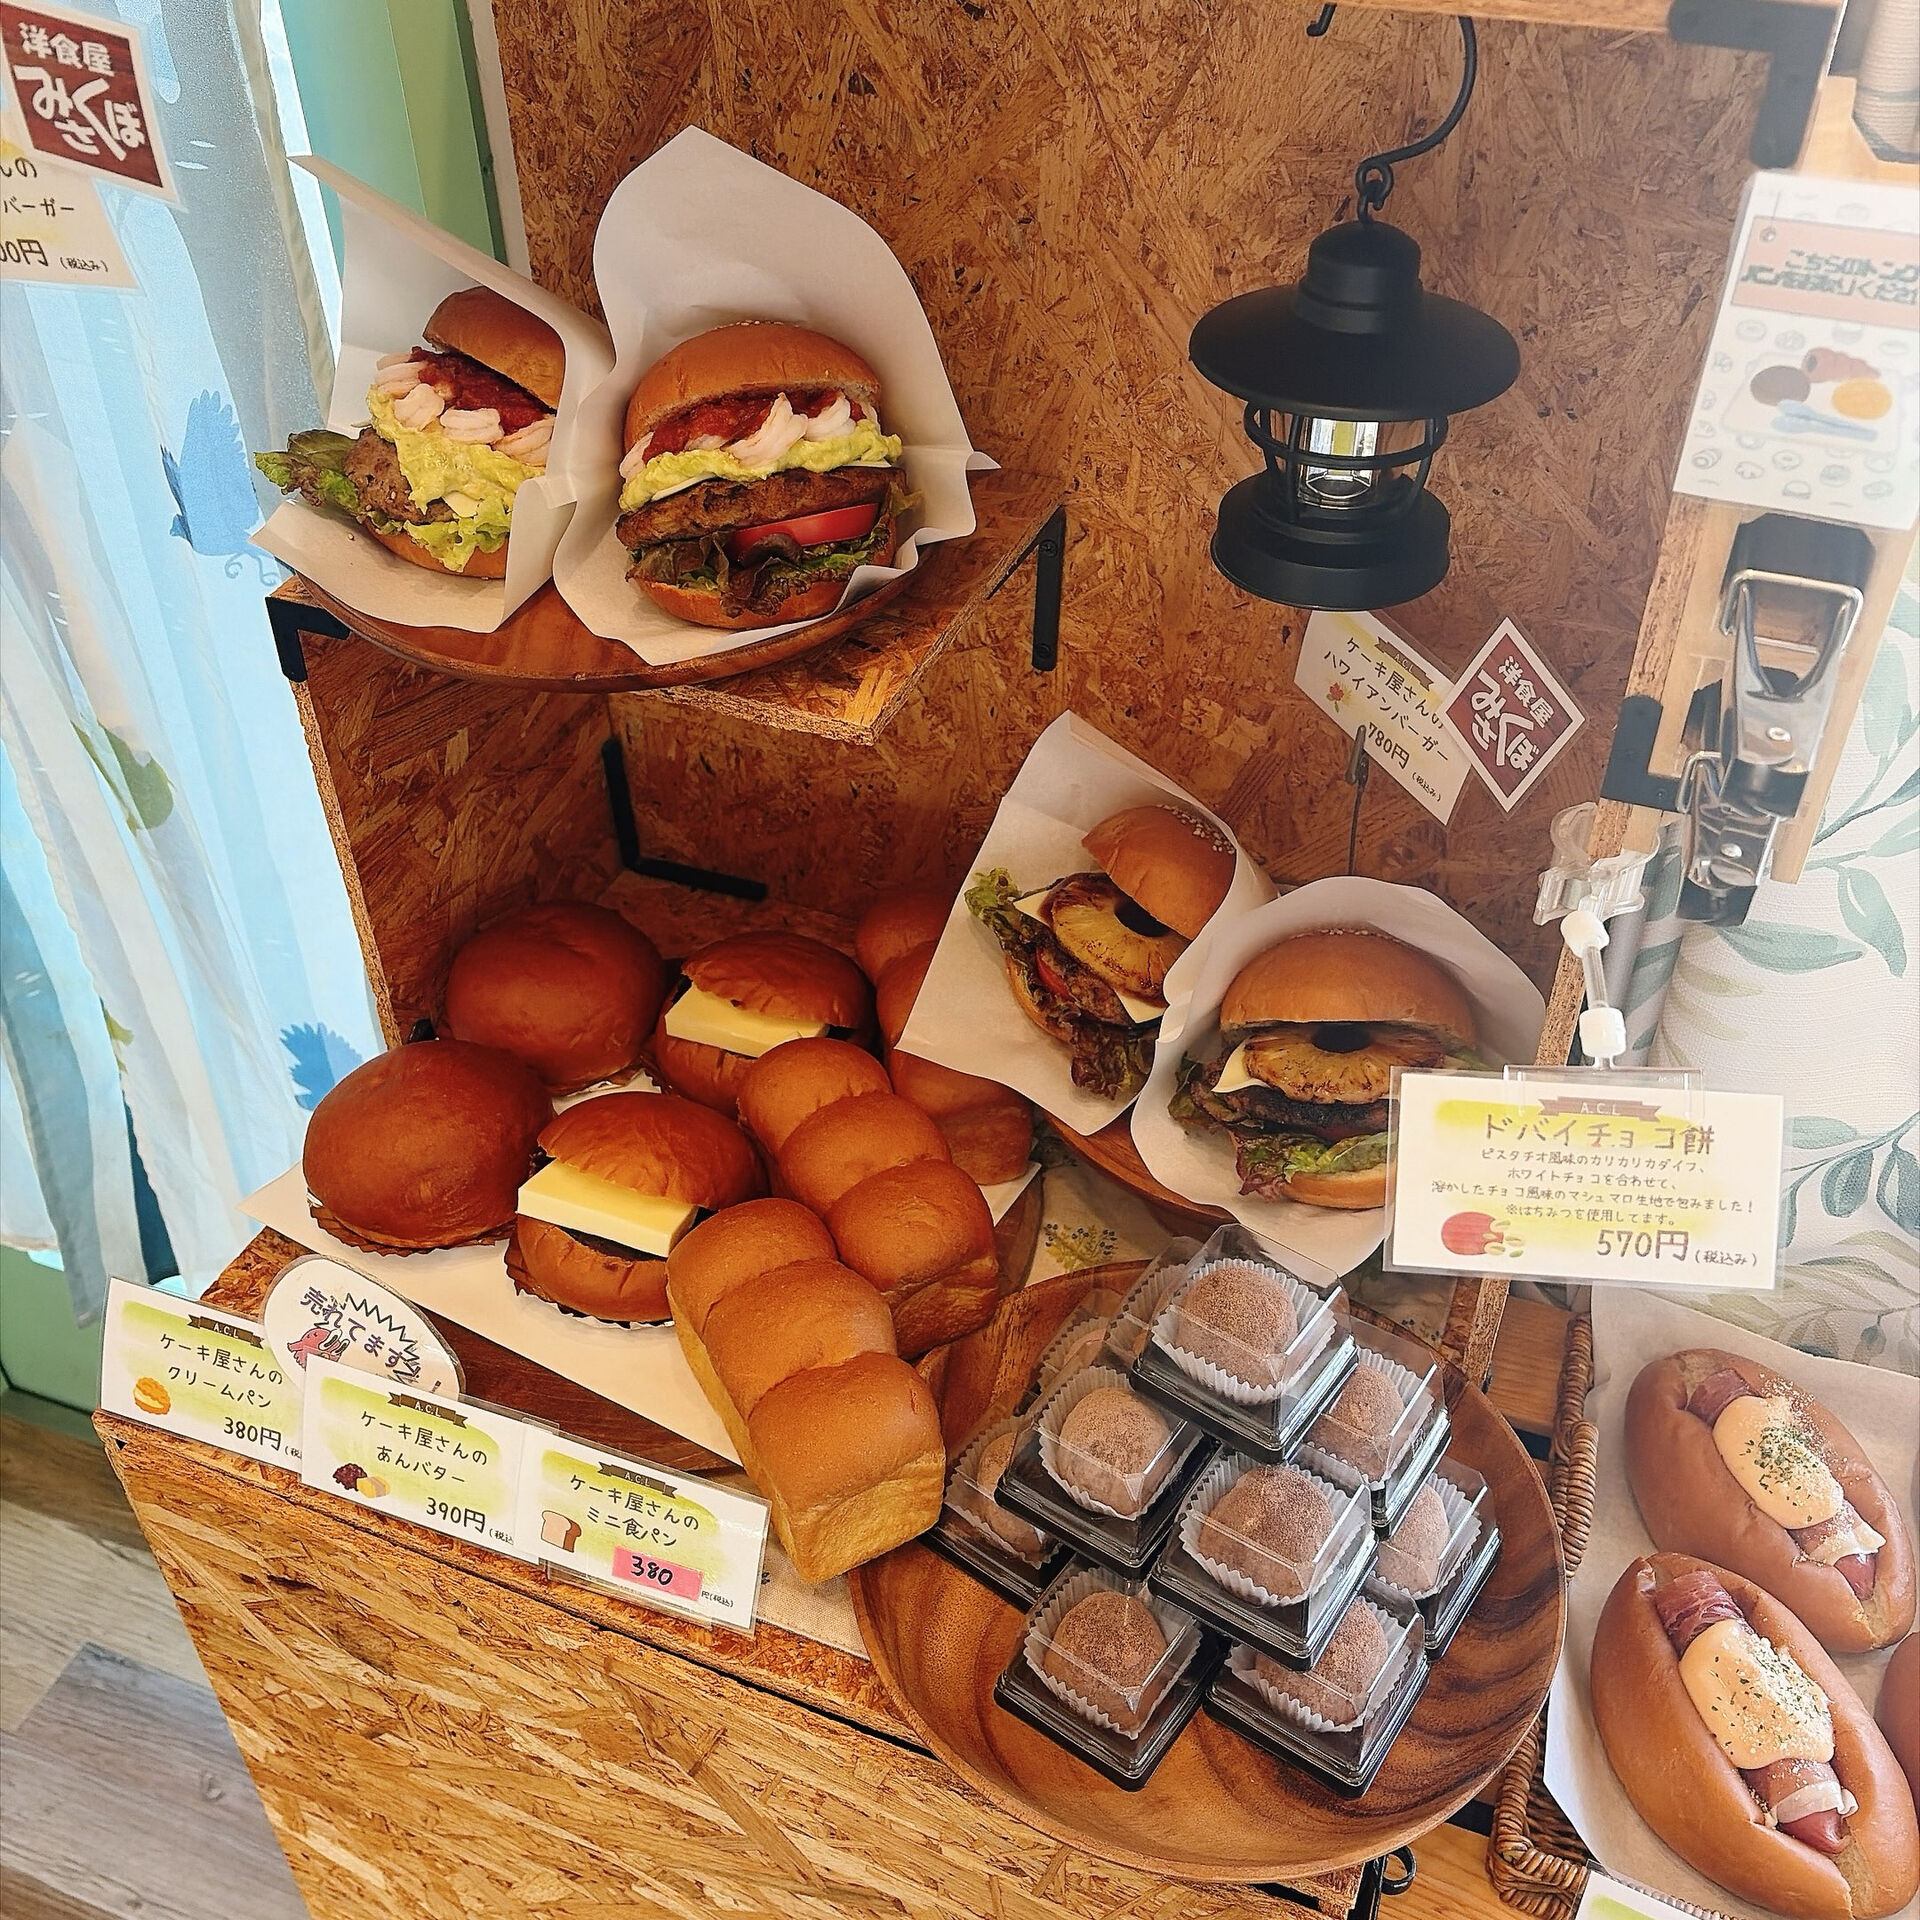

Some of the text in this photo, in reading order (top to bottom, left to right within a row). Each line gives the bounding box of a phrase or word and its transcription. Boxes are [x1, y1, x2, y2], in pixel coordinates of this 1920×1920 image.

[18, 21, 114, 77] 洋食屋
[3, 196, 74, 217] バーガー
[1347, 637, 1445, 730] ケーキ屋さんの
[1498, 655, 1555, 729] 洋食屋
[1324, 651, 1449, 761] ハワイアンバーガー
[1368, 722, 1410, 770] 780円
[1486, 1114, 1715, 1155] ドバイチョコ餅
[1508, 1168, 1677, 1190] ホワイトチョコを合わせて、
[1596, 1229, 1757, 1267] 570円 (税込み)
[160, 1334, 283, 1385] ケーキ屋さんの
[168, 1366, 271, 1408] クリームパン
[224, 1417, 281, 1451] 380円
[361, 1411, 488, 1466] ケーキ屋さんの
[377, 1445, 465, 1483] あんバター
[426, 1497, 486, 1534] 390円
[570, 1475, 699, 1531] ケーキ屋さんの
[587, 1506, 677, 1546] ミニ食パン
[630, 1555, 673, 1586] 380
